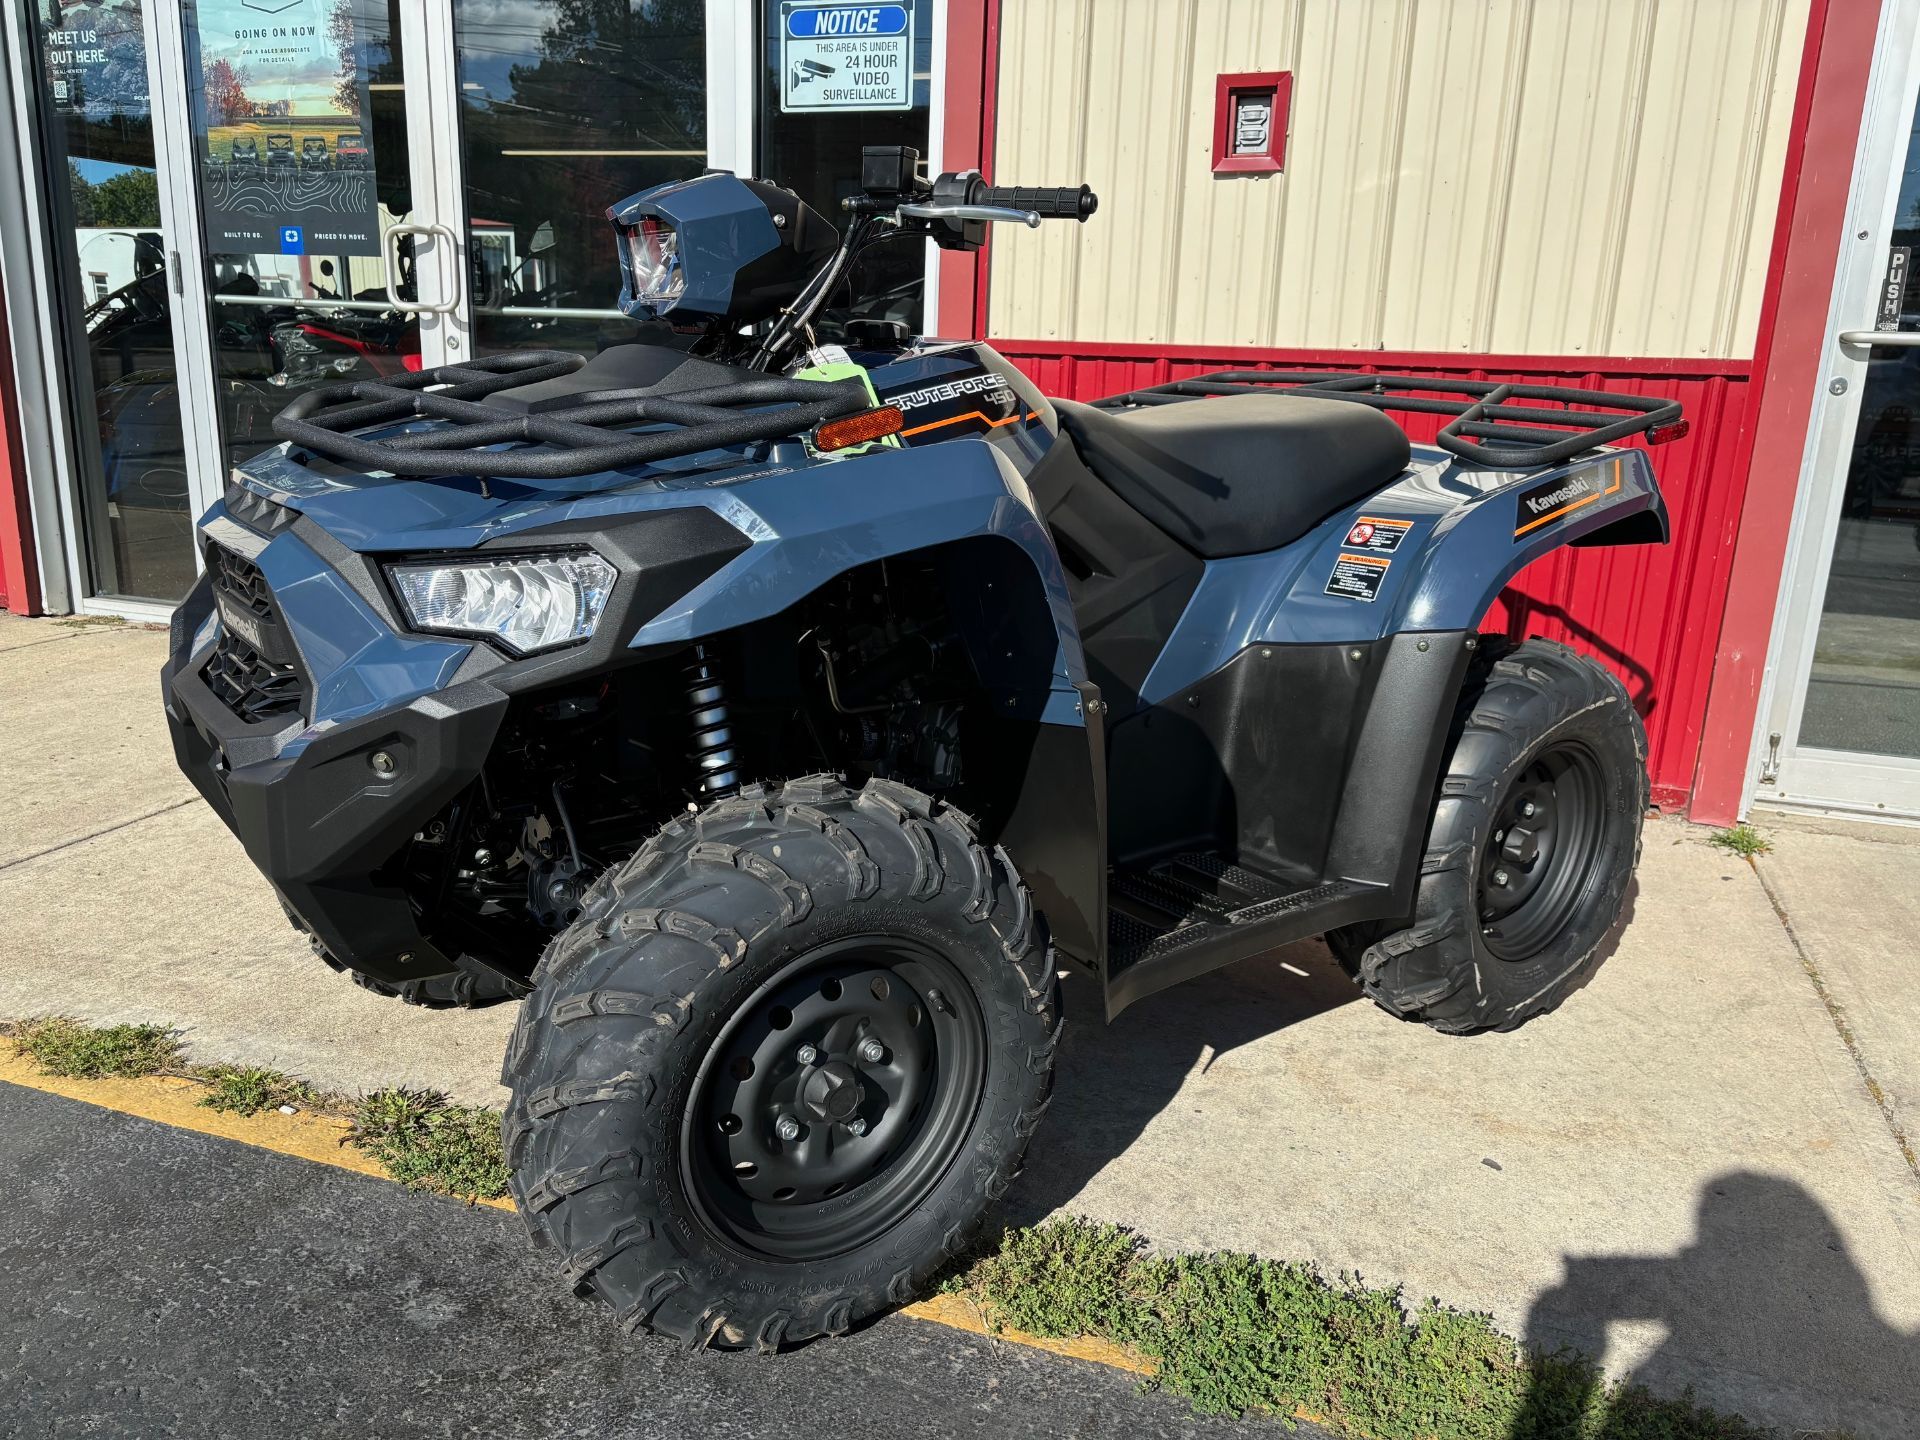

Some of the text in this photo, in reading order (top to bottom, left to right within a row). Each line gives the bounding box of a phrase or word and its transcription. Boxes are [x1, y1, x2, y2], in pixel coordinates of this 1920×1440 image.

[814, 9, 880, 34] NOTICE
[48, 29, 97, 45] MEET US
[234, 26, 315, 39] GOING ON NOW
[816, 41, 898, 53] THIS AREA IS UNDER
[51, 49, 109, 64] OUT HERE.
[845, 54, 898, 68] 24 HOUR
[853, 71, 890, 85] VIDEO
[823, 88, 897, 100] SURVEILLANCE
[348, 233, 368, 241] MOVE.
[1884, 253, 1905, 315] PUSH
[983, 389, 1017, 405] 450
[1526, 476, 1590, 514] Kawasaki
